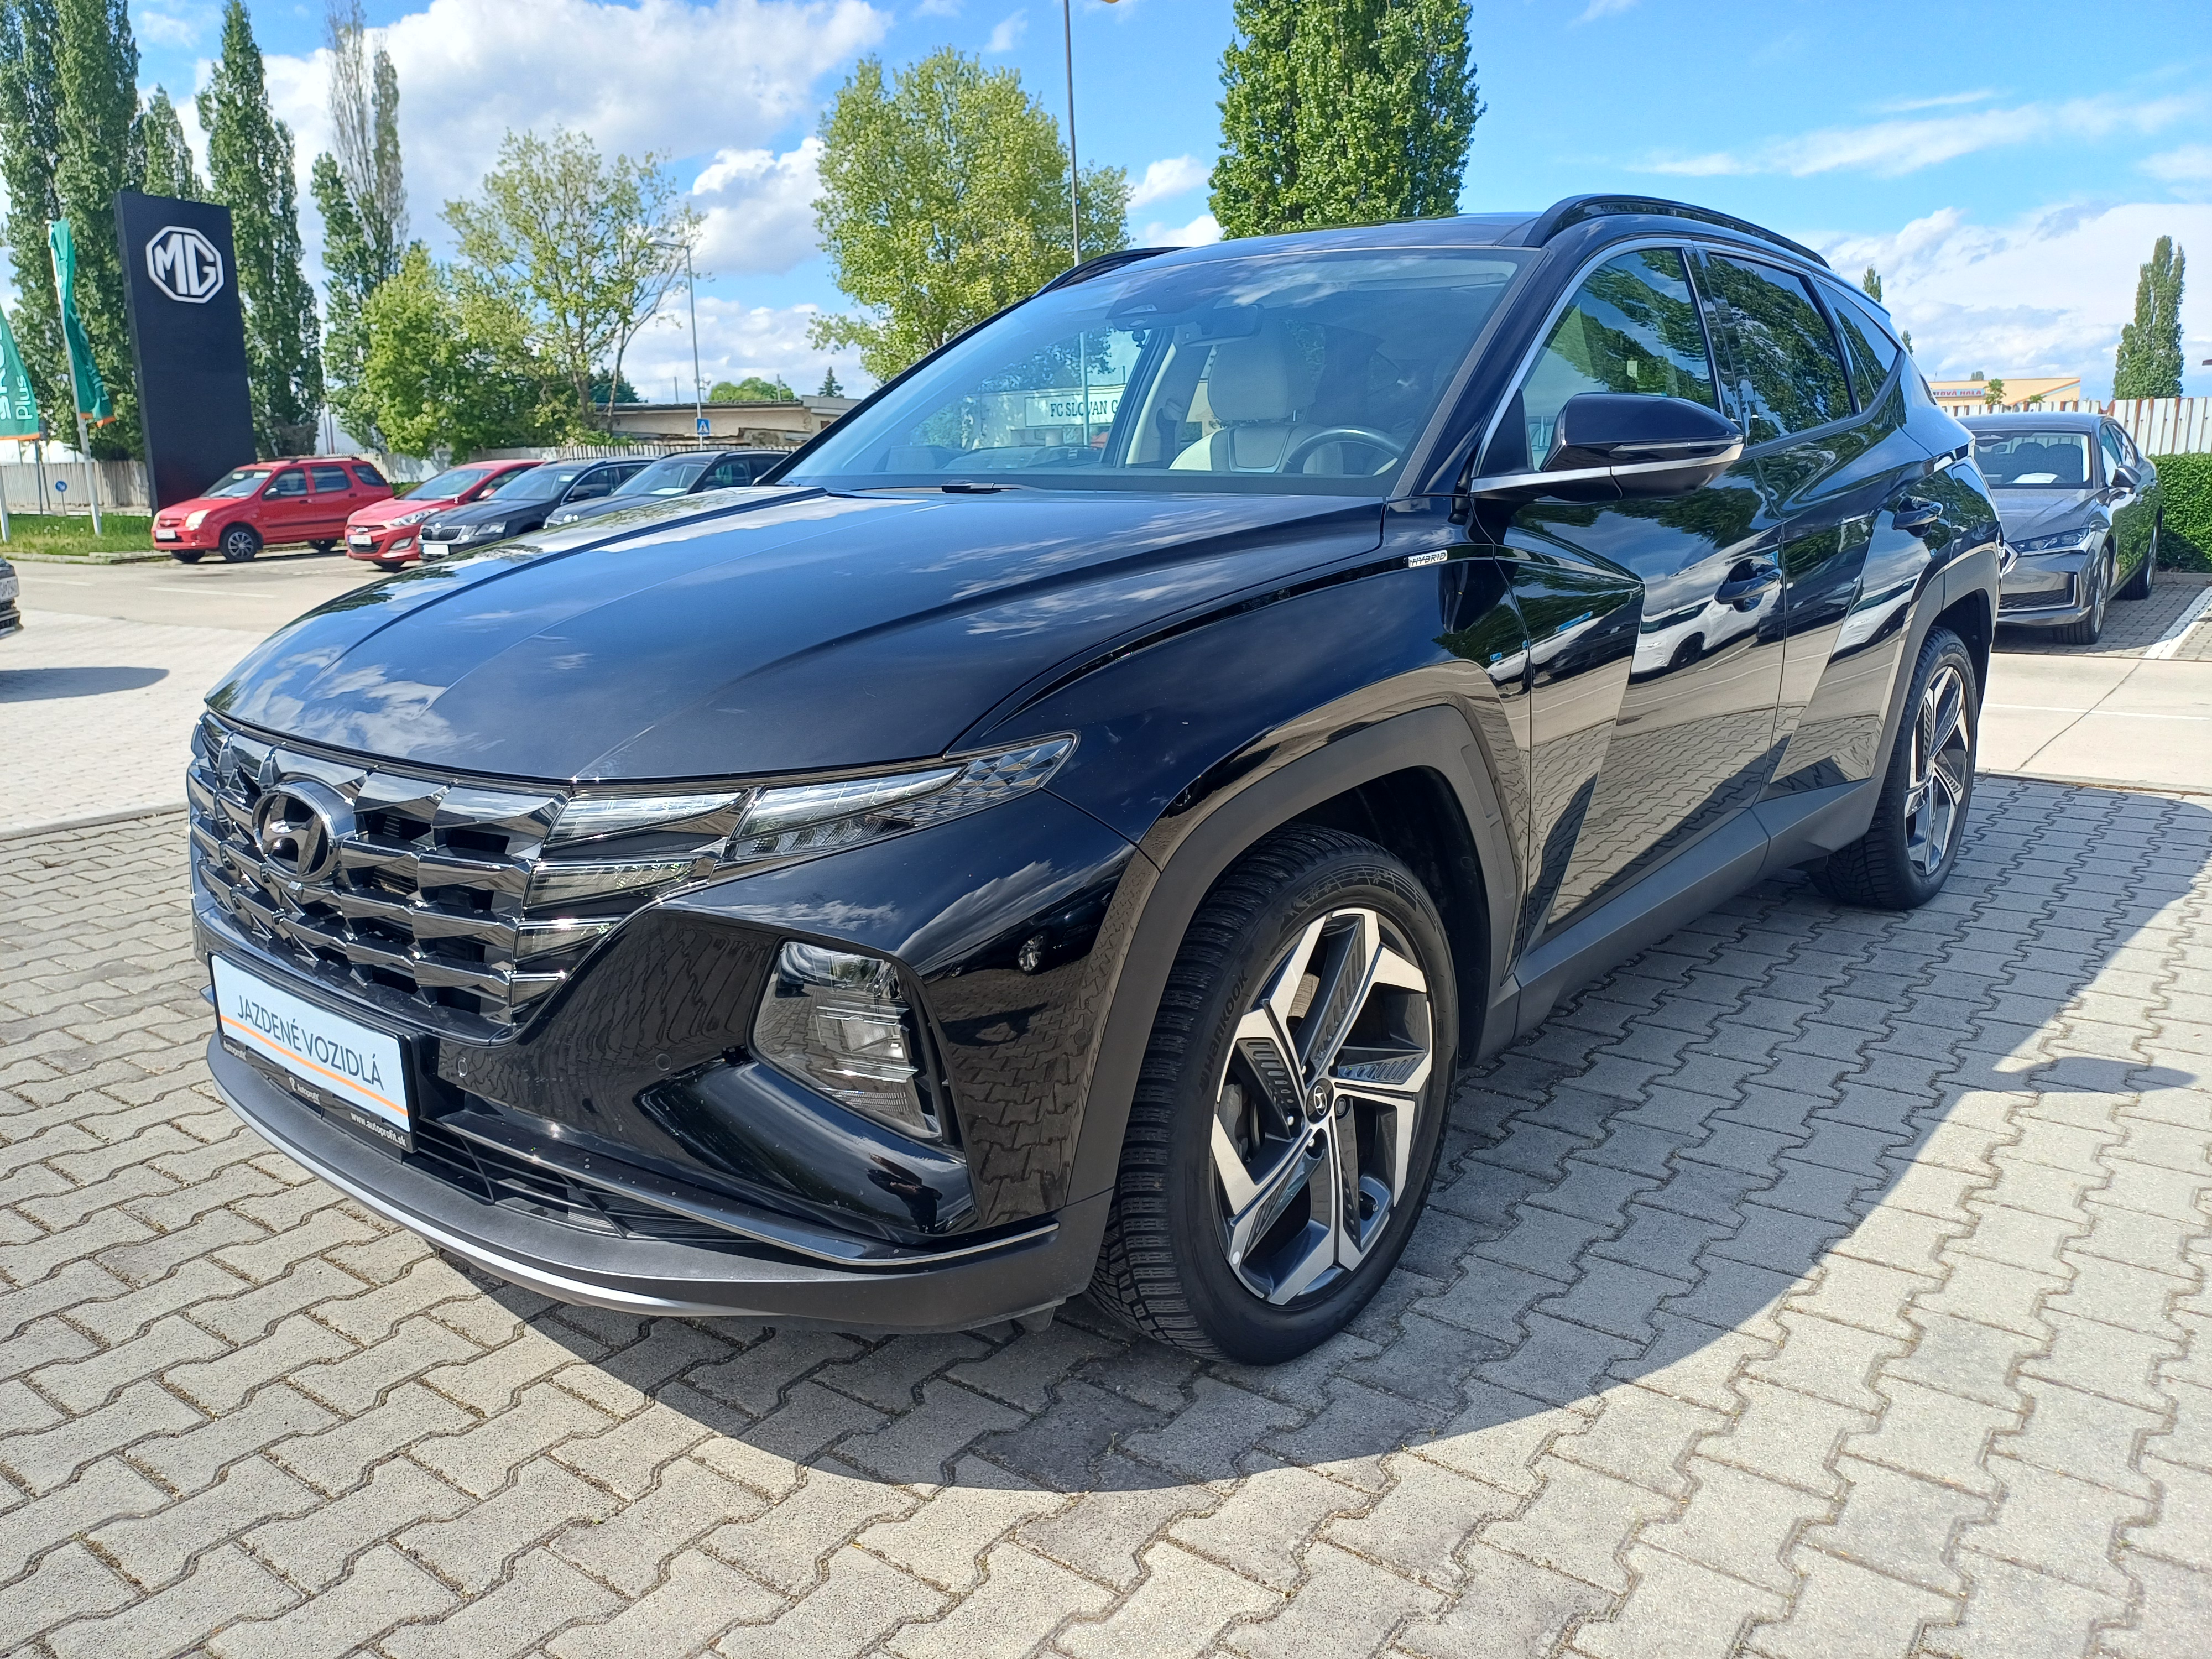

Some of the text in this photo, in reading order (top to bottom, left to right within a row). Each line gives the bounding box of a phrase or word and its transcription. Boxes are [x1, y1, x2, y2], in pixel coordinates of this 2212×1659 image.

[154, 233, 216, 295] MG
[1050, 403, 1063, 417] FC
[1410, 552, 1447, 566] HYBRID
[238, 995, 384, 1091] JAZDENÉ VOZIDLÁ
[350, 1112, 407, 1147] www.autoprofit.sk
